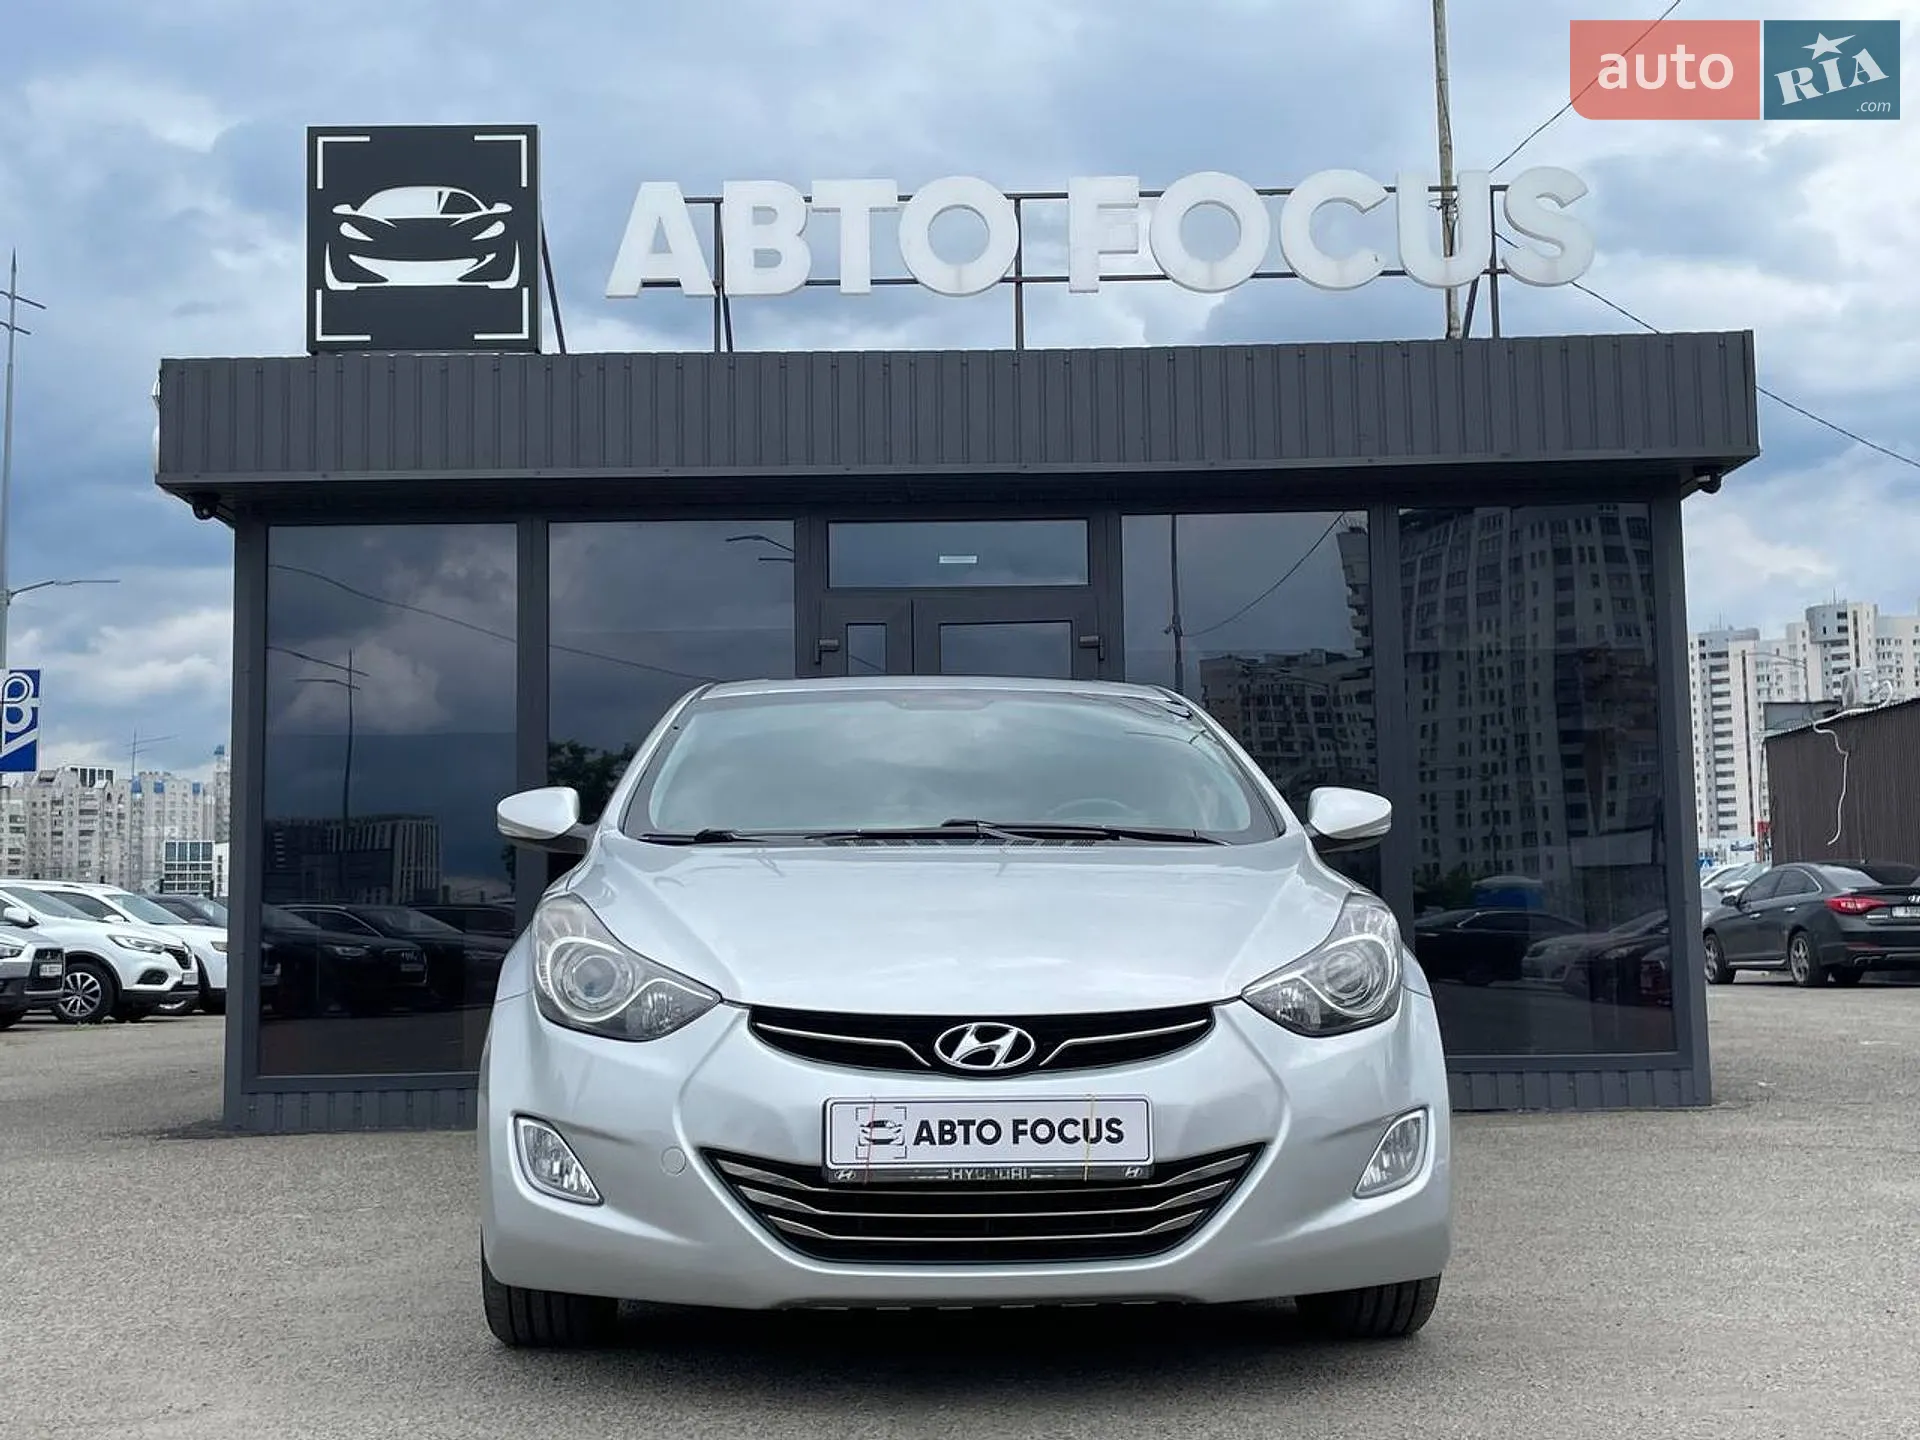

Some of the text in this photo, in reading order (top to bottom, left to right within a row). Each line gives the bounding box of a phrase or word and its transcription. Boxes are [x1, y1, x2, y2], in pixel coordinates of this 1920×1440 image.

[606, 166, 1594, 298] АВТО FOCUS
[913, 1117, 1125, 1146] АВТО FOCUS
